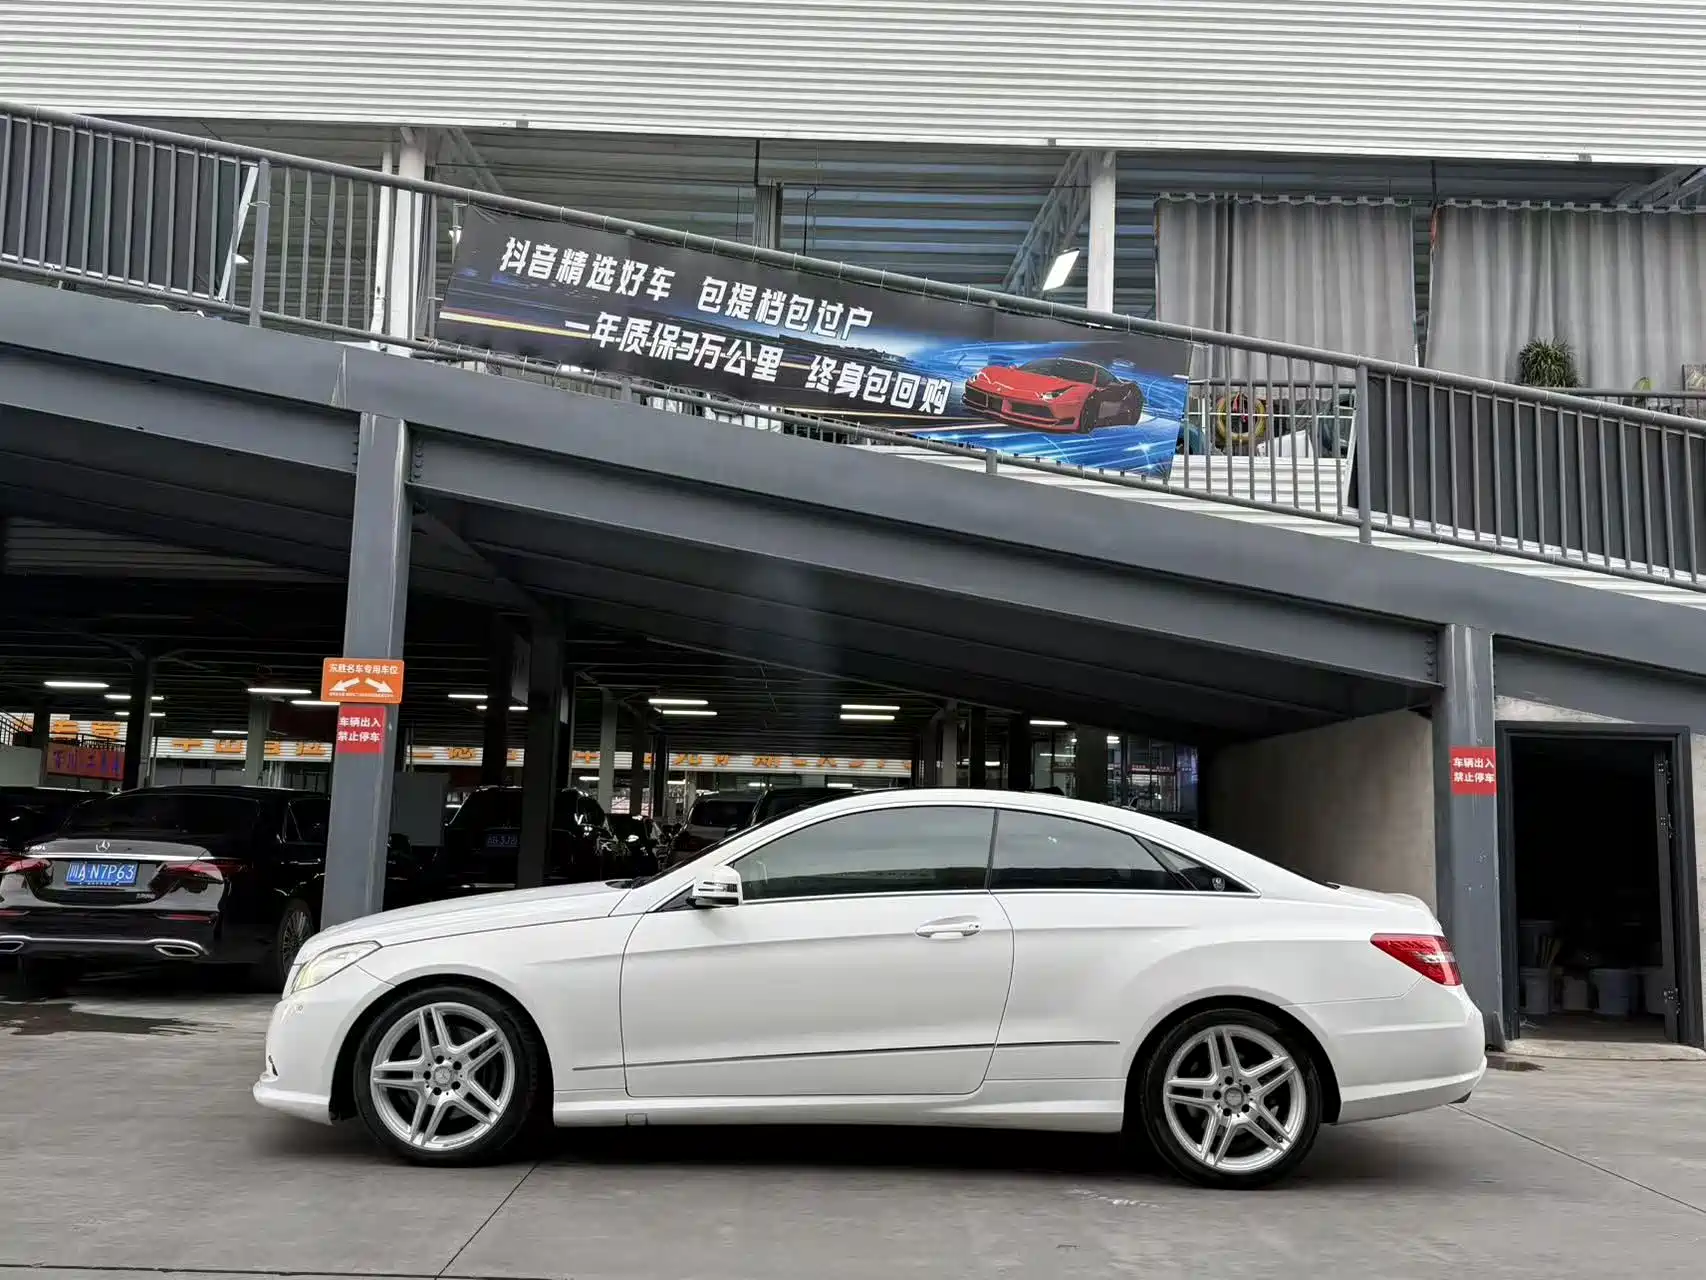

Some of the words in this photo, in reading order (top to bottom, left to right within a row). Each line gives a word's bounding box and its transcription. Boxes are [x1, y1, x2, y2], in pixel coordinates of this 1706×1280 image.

[499, 237, 676, 302] 抖音精选好车
[696, 276, 873, 341] 包提档包过户
[564, 311, 784, 383] 一年质保3万公里
[804, 355, 952, 416] 终身包回购
[338, 717, 381, 728] 车辆出入
[337, 731, 380, 742] 禁止停车
[1452, 757, 1494, 768] 车辆出入
[1453, 772, 1496, 784] 禁止停车
